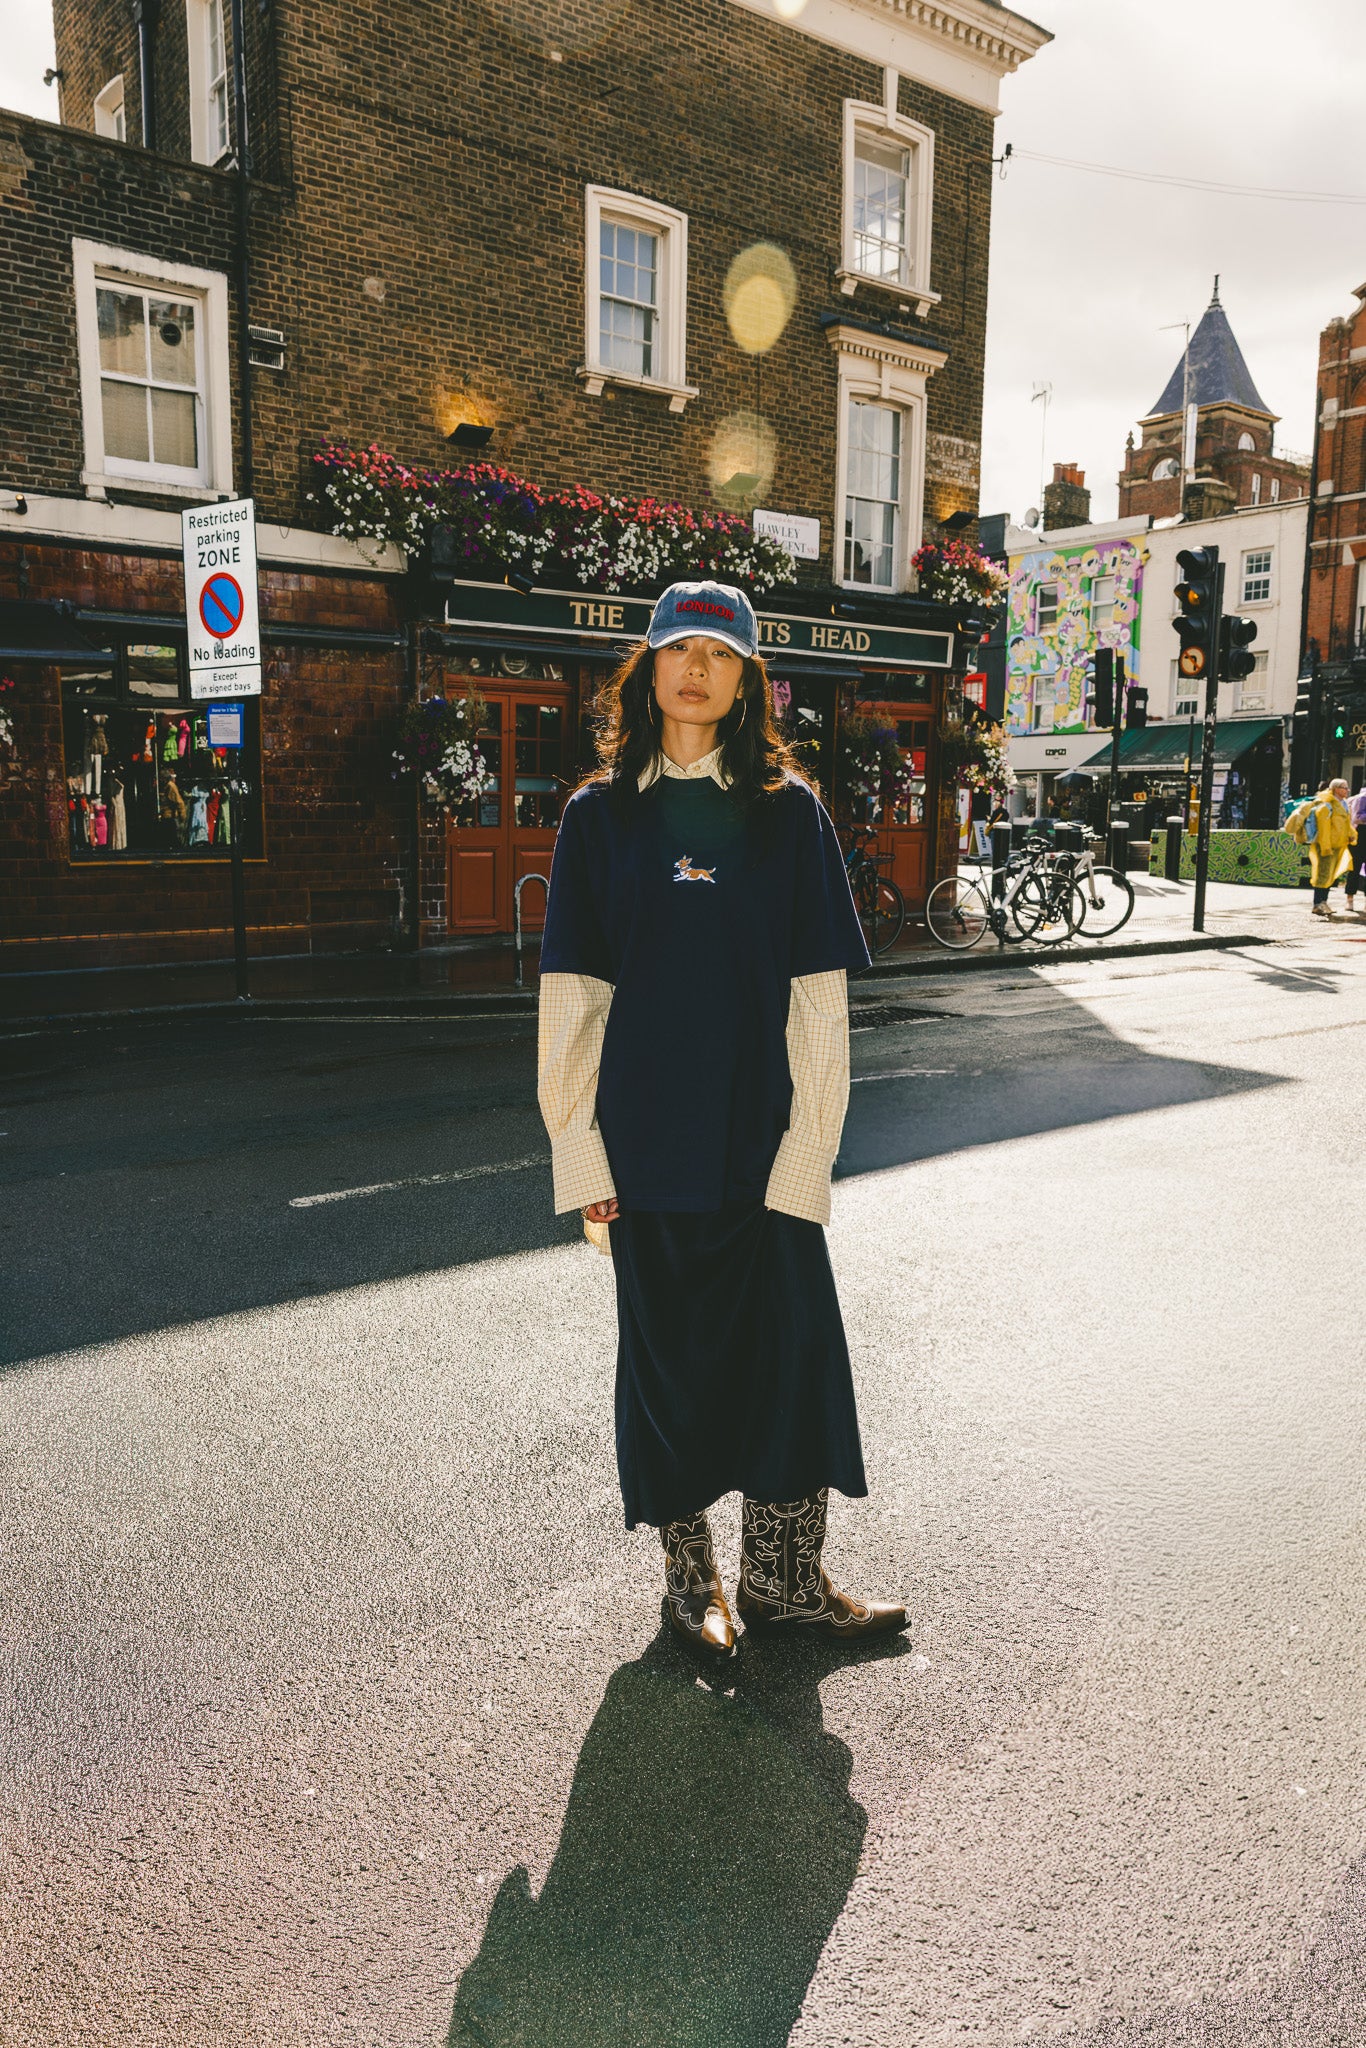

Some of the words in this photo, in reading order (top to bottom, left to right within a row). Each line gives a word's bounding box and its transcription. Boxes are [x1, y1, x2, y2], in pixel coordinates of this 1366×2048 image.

[189, 506, 248, 529] Restricted
[197, 529, 240, 548] parking
[758, 522, 801, 539] HAWLEY
[198, 547, 241, 569] ZONE
[569, 601, 625, 629] THE
[676, 599, 735, 622] LONDON
[810, 626, 871, 652] HEAD
[194, 648, 210, 661] No
[214, 644, 255, 660] loading
[213, 672, 238, 683] Except
[201, 685, 207, 693] in
[209, 684, 232, 694] signed
[234, 682, 251, 692] bays
